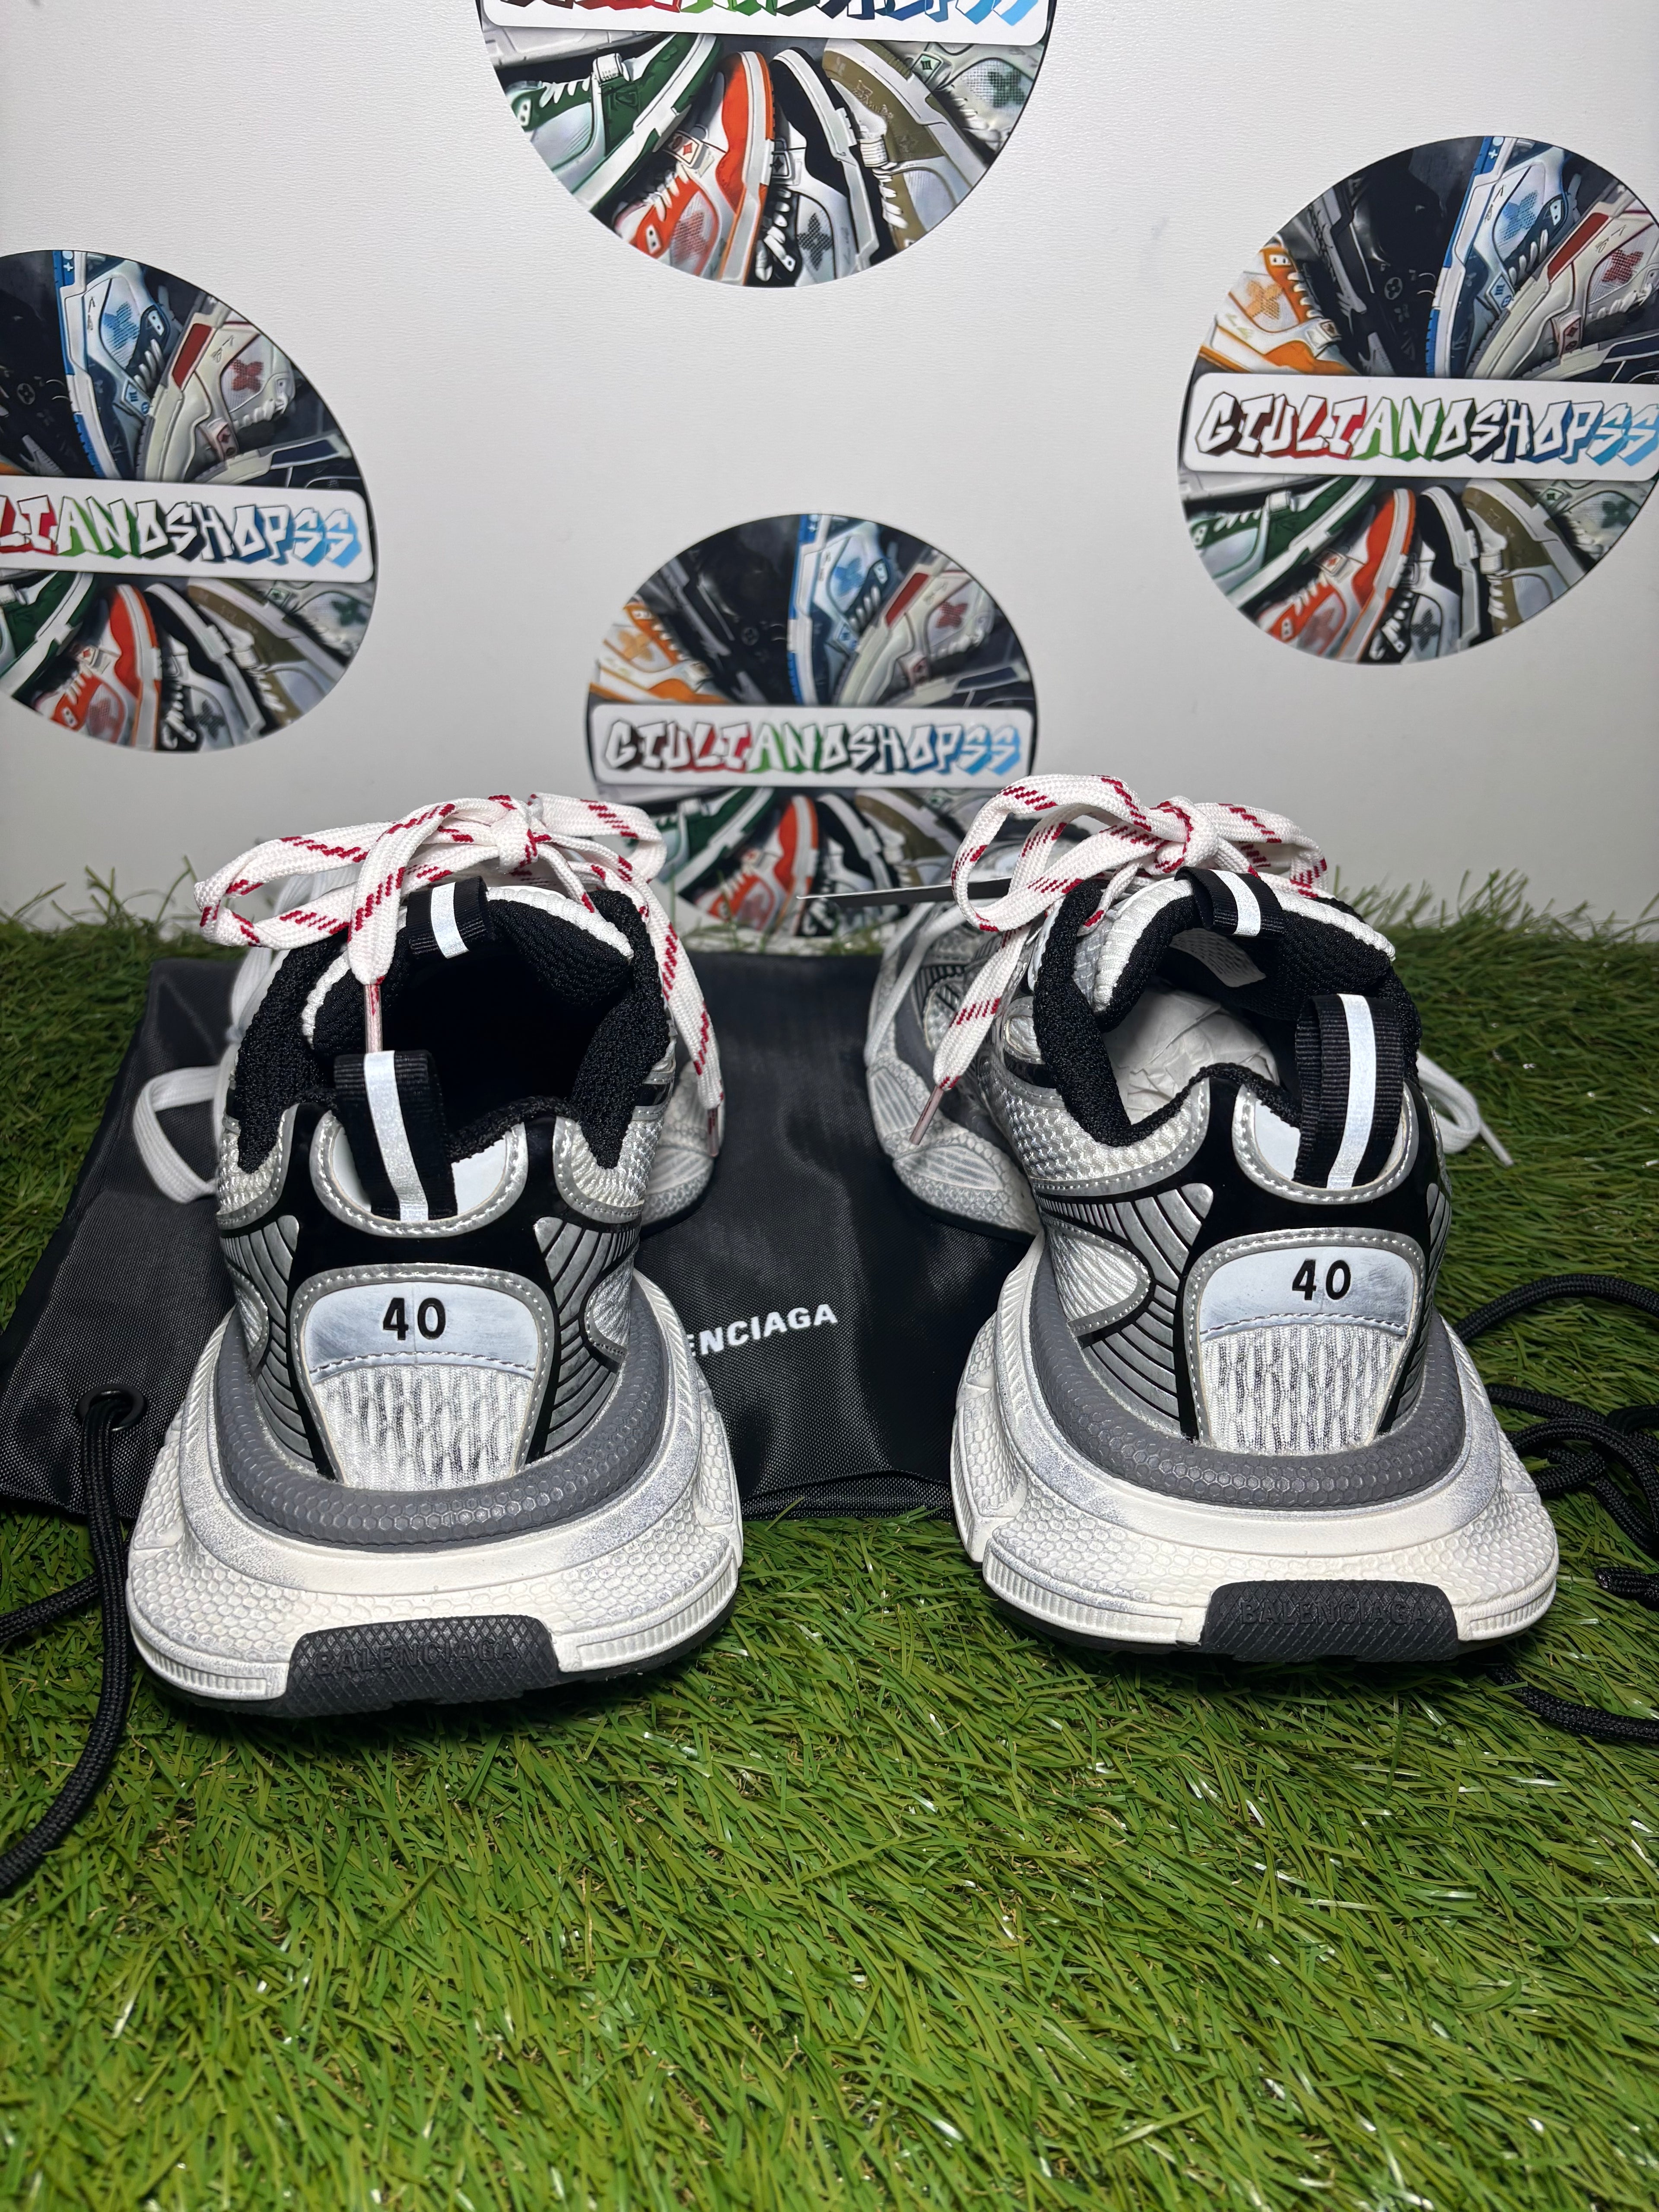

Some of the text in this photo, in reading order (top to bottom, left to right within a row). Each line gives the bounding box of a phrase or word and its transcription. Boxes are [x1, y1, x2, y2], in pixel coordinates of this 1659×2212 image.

[1292, 1259, 1351, 1300] 40
[383, 1297, 446, 1341] 40
[1241, 1602, 1428, 1624] BALENCIAGA
[316, 1638, 517, 1675] BALENCIAGA
